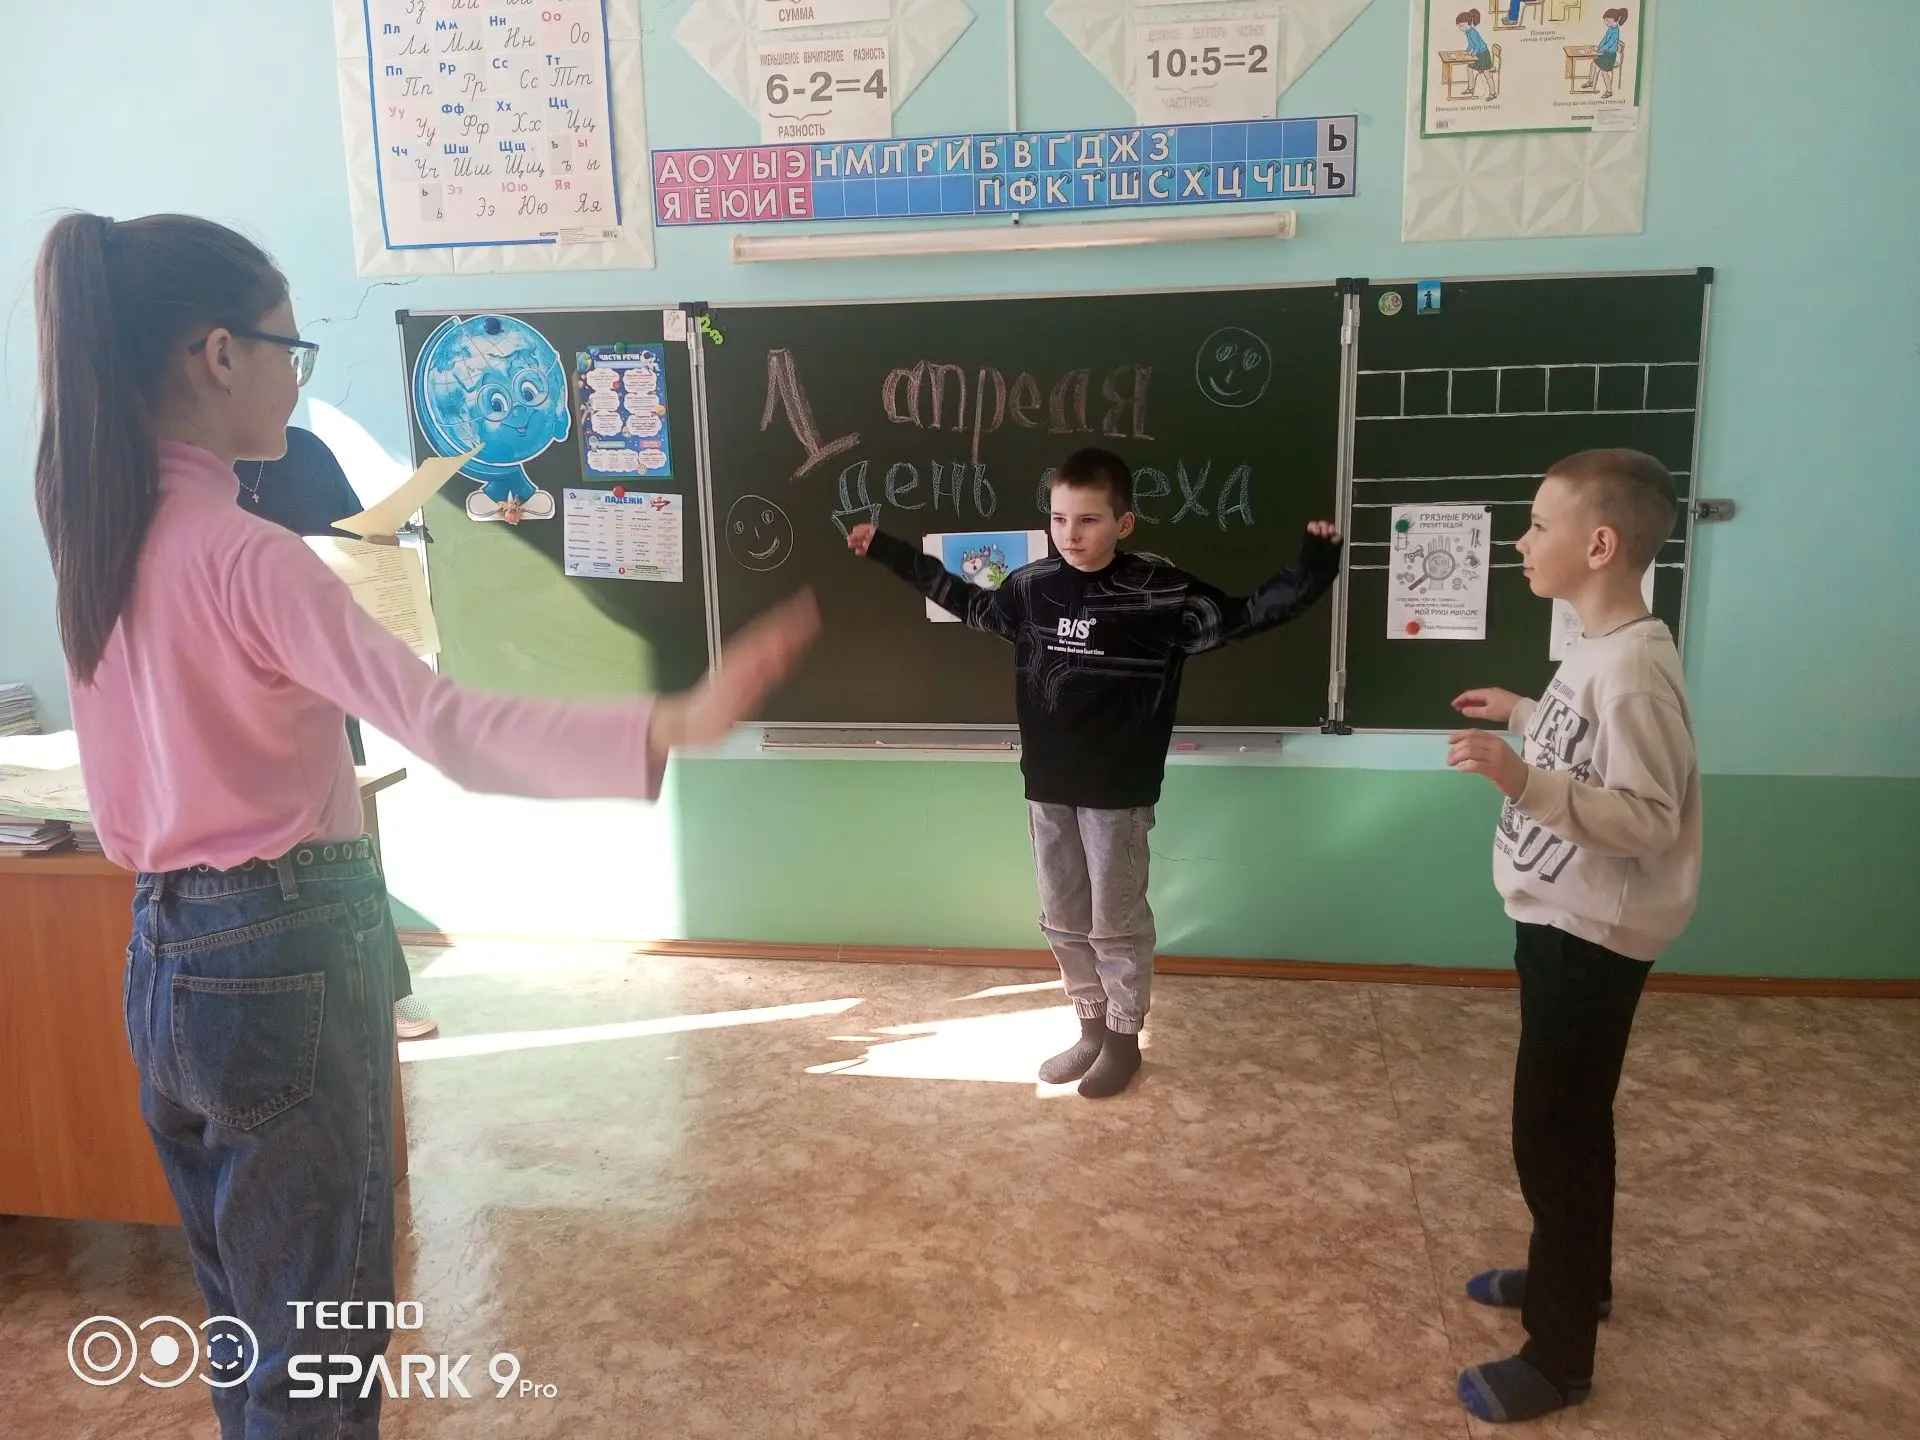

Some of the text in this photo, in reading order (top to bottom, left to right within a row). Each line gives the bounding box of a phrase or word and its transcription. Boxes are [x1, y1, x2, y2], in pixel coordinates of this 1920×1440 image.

[778, 6, 815, 22] СУММА
[803, 49, 844, 64] ВЫЧИТАЕМОЕ
[853, 47, 886, 62] РАЗНОСТЬ
[1161, 95, 1213, 110] ЧАСТНОЕ
[778, 123, 826, 138] РАЗНОСТЬ
[598, 353, 640, 361] ЧАСТИ РЕЧИ
[604, 495, 643, 505] ПАДЕЖИ
[1035, 455, 1255, 532] сеха
[1420, 513, 1459, 521] ГРЯЗНЫЕ
[1414, 608, 1430, 616] МОЙ
